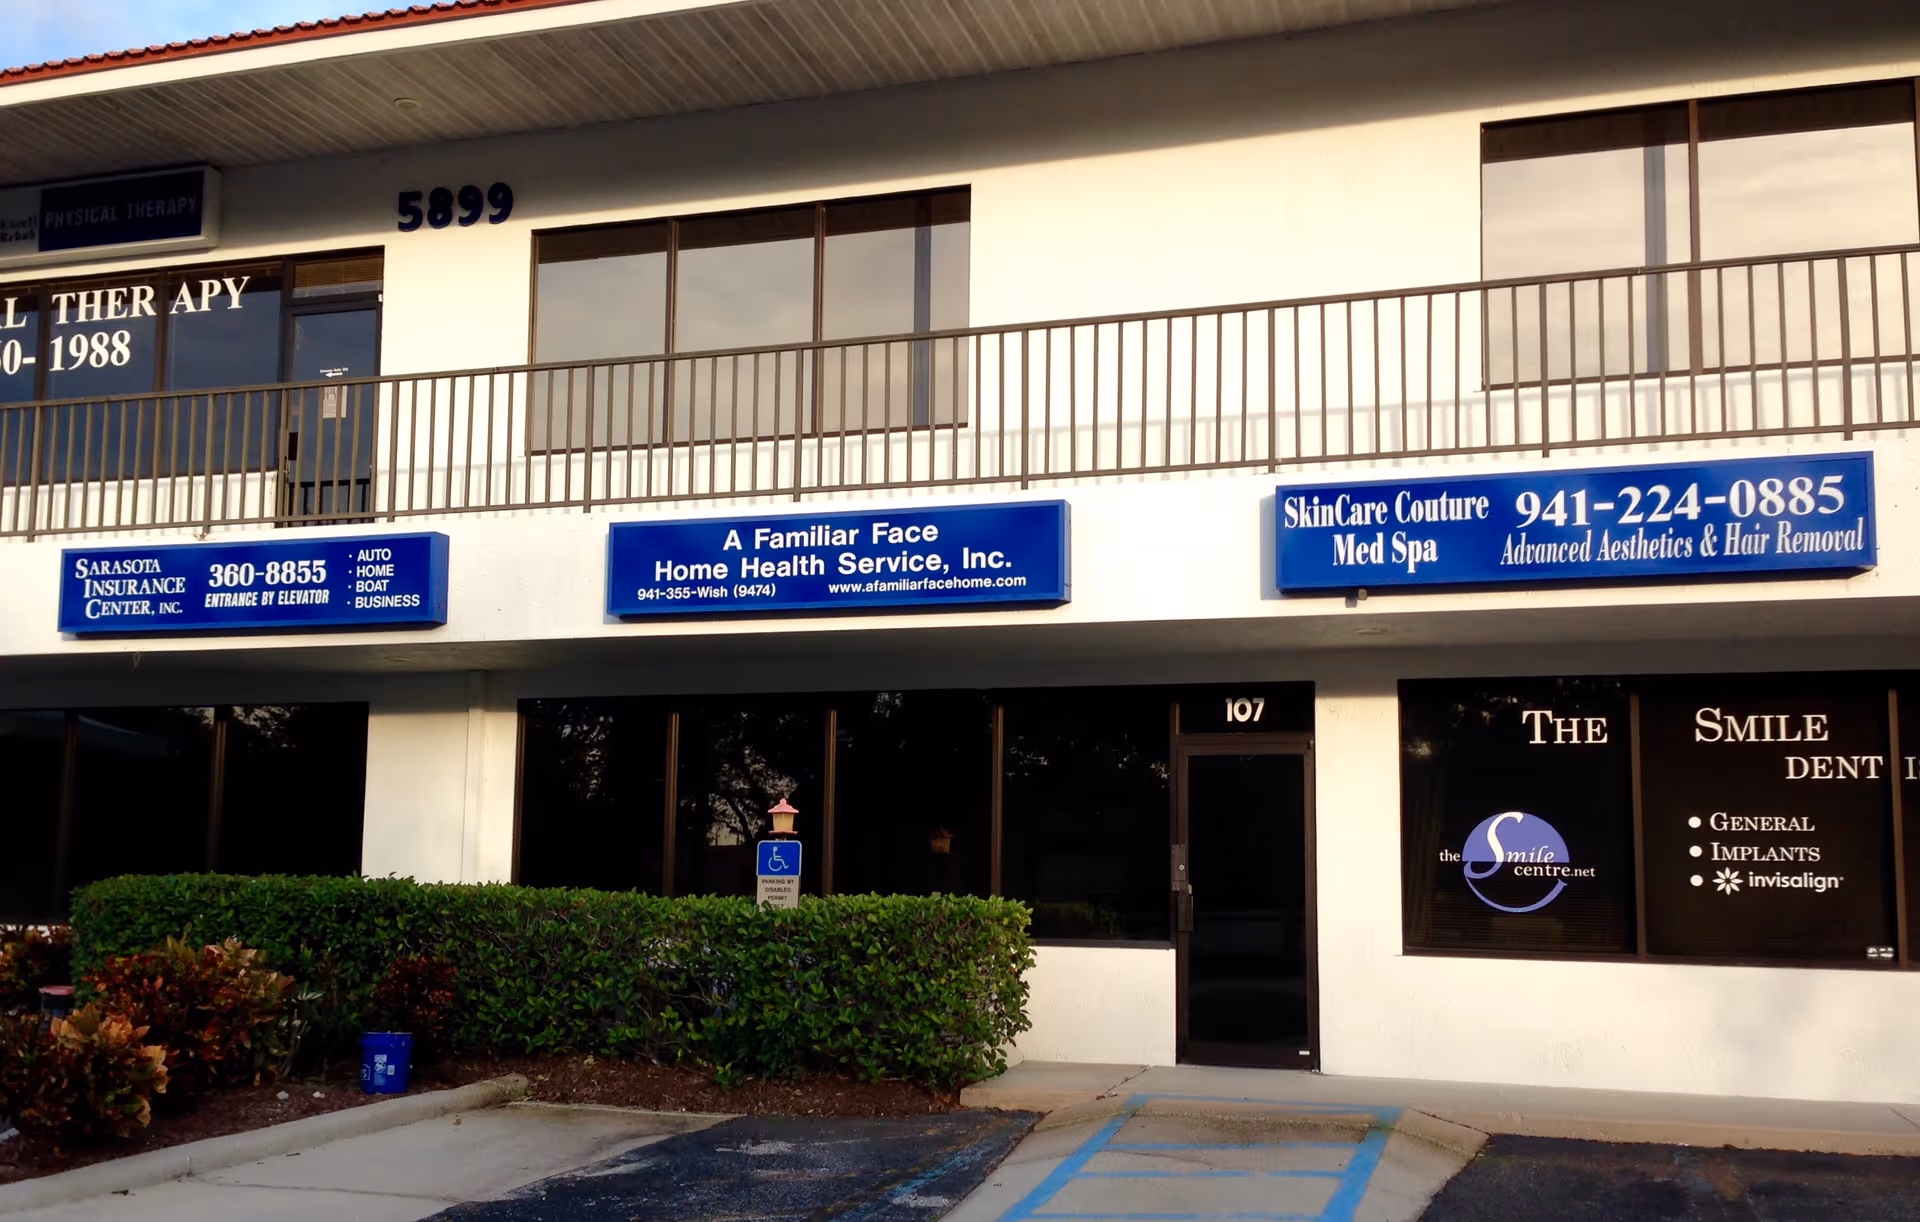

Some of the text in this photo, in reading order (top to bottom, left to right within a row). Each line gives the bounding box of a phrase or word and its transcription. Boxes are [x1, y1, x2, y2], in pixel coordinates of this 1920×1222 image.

[45, 195, 198, 230] PHYSICAL THERAPY
[398, 182, 513, 232] 5899
[0, 297, 27, 329] L
[49, 330, 131, 371] 1988
[1285, 491, 1489, 528] SkinCare Couture
[1516, 474, 1844, 529] 941-224-0885
[723, 522, 938, 550] A Familiar Face
[1500, 516, 1864, 564] Advanced Aesthetics & Hair Removal
[358, 548, 391, 561] AUTO
[1333, 531, 1438, 573] Med Spa
[76, 559, 161, 578] SARASOTA
[209, 560, 326, 587] 360-8855
[357, 564, 394, 577] HOME
[656, 547, 1011, 581] Home Health Service, Inc.
[84, 577, 185, 598] INSURANCE
[356, 580, 389, 592] BOAT
[638, 583, 775, 600] 941-355-Wish (9474)
[829, 574, 1027, 594] www.afamiliarfacehome.com
[205, 589, 329, 607] ENTRANCE BY ELEVATOR
[355, 594, 420, 608] BUSINESS
[86, 599, 182, 619] CENTER, INC.
[1227, 700, 1264, 722] 107
[1522, 708, 1828, 744] THE SMILE
[1710, 812, 1815, 831] GENERAL
[1466, 811, 1555, 877] Smile
[1711, 842, 1820, 861] IMPLANTS
[1440, 849, 1460, 861] the
[1514, 864, 1595, 877] centre.net
[1749, 872, 1838, 892] invisalign
